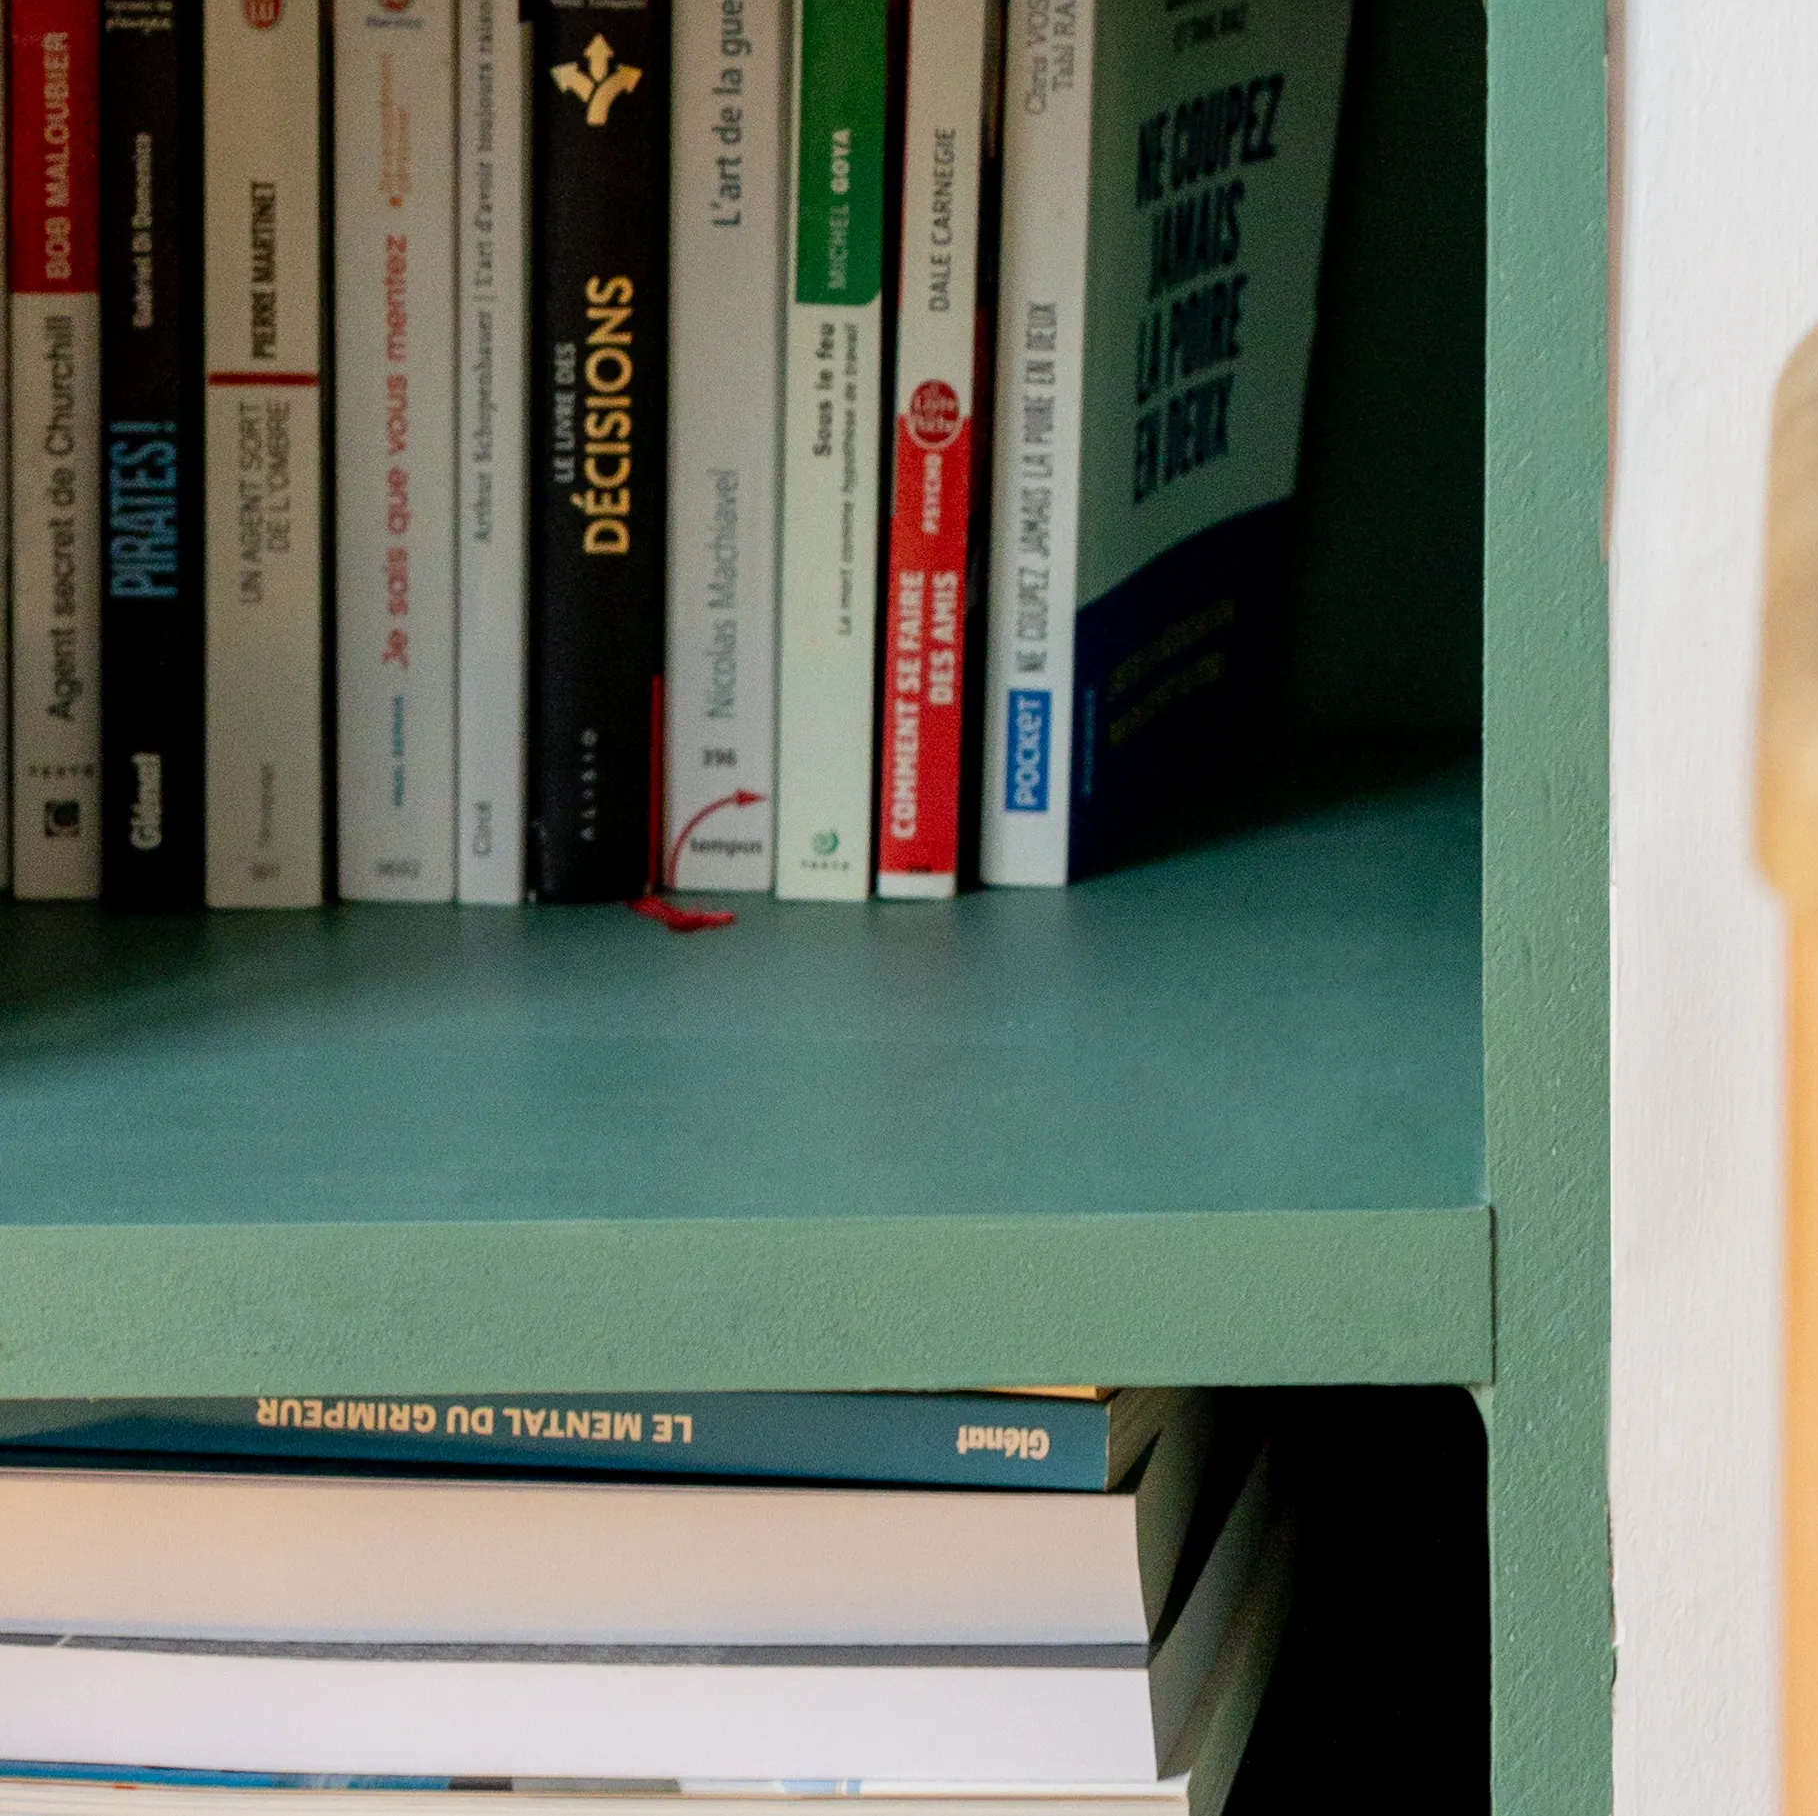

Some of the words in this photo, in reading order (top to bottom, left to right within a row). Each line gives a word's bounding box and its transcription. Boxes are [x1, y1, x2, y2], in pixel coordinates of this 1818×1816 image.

[43, 31, 70, 208] MALOUBIER
[931, 128, 955, 245] CARNEGIE
[45, 217, 72, 280] BOB
[928, 254, 951, 311] DALE
[385, 233, 408, 363] mentez
[43, 314, 76, 457] Churchill
[385, 375, 409, 457] vous
[570, 275, 635, 555] DÉCISIONS
[48, 467, 75, 506] de
[386, 468, 415, 536] que
[48, 517, 75, 618] secret
[383, 547, 409, 618] sais
[897, 571, 924, 651] FAIRE
[932, 571, 958, 642] AMIS
[47, 628, 86, 722] Agent
[383, 629, 409, 670] Je
[897, 658, 921, 692] SE
[930, 650, 956, 705] DES
[892, 702, 919, 840] COMMENT
[256, 1397, 437, 1434] GRIMPEUR
[446, 1405, 495, 1435] DU
[503, 1410, 641, 1442] MENTAL
[651, 1415, 693, 1444] LE
[956, 1424, 1049, 1460] Glénat
